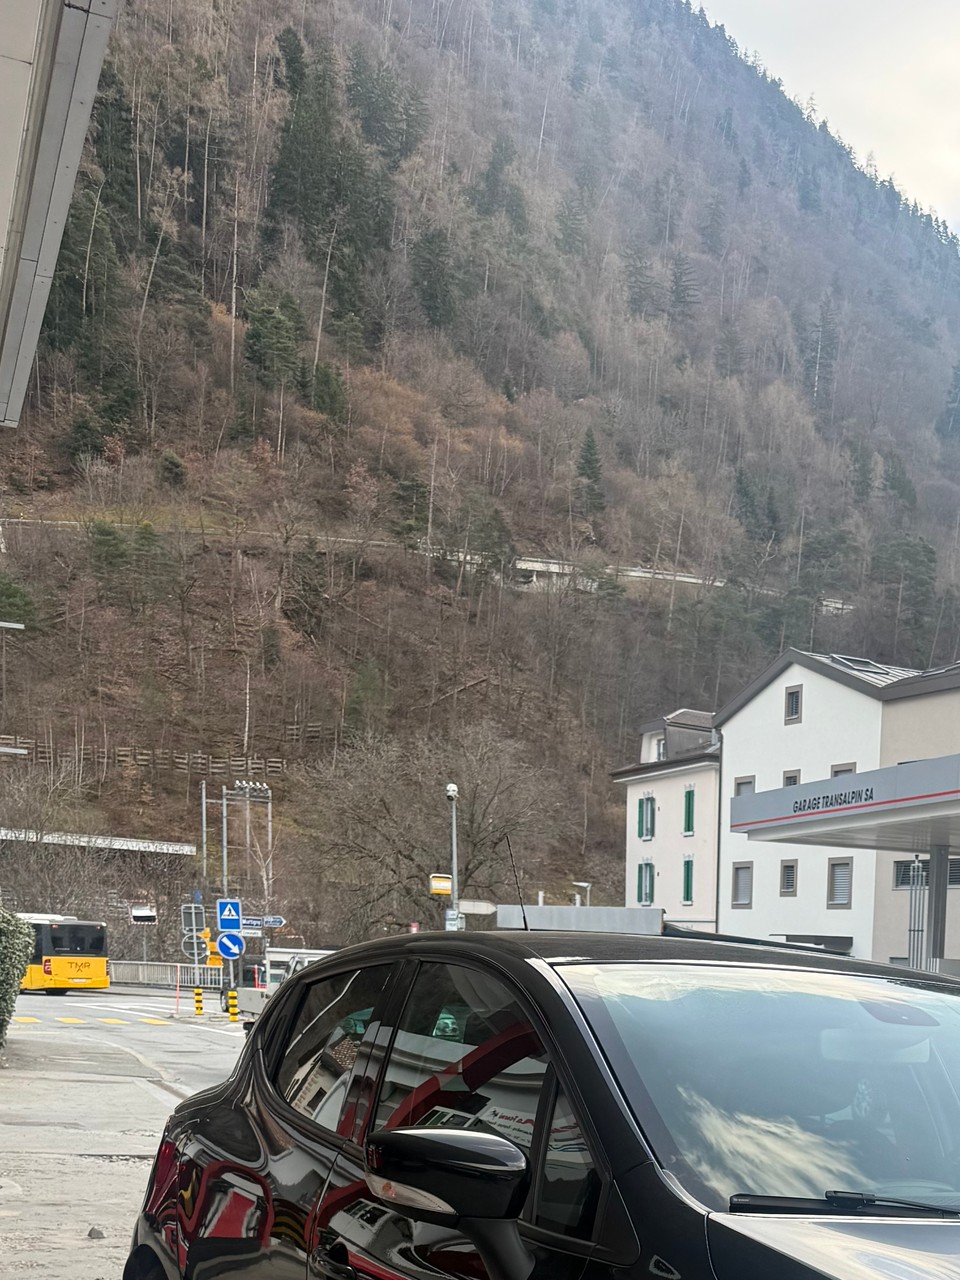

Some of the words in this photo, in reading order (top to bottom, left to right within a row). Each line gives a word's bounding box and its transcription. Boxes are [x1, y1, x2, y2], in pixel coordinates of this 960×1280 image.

[792, 796, 821, 813] GARAGE
[821, 789, 863, 808] TRANSALPIN
[864, 787, 874, 802] SA
